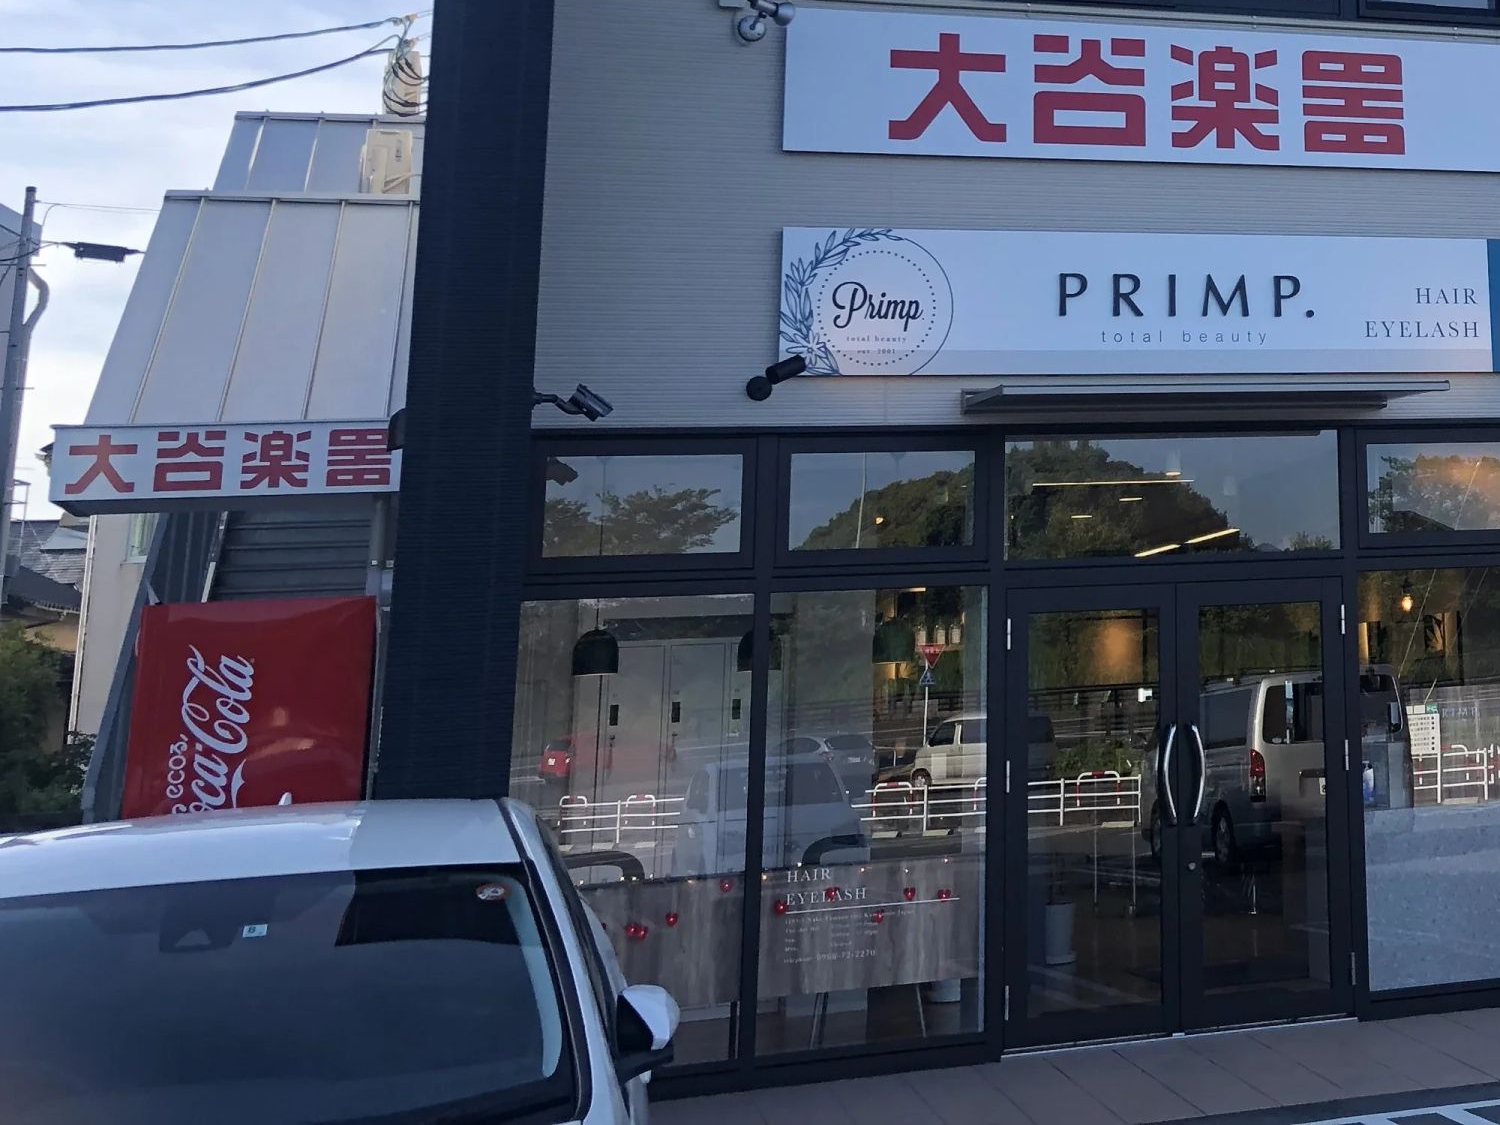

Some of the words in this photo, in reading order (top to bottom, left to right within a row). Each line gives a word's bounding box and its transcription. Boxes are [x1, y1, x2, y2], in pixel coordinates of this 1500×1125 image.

[888, 31, 1406, 156] 大谷楽器
[1415, 287, 1479, 305] HAIR
[831, 281, 924, 332] Primp
[1101, 329, 1164, 344] total
[1182, 329, 1268, 346] beauty
[1365, 320, 1480, 339] EYELASH
[64, 428, 393, 495] 大谷楽器
[172, 643, 255, 814] oca-Cola
[787, 867, 832, 883] HAIR
[786, 887, 867, 906] EYELASH
